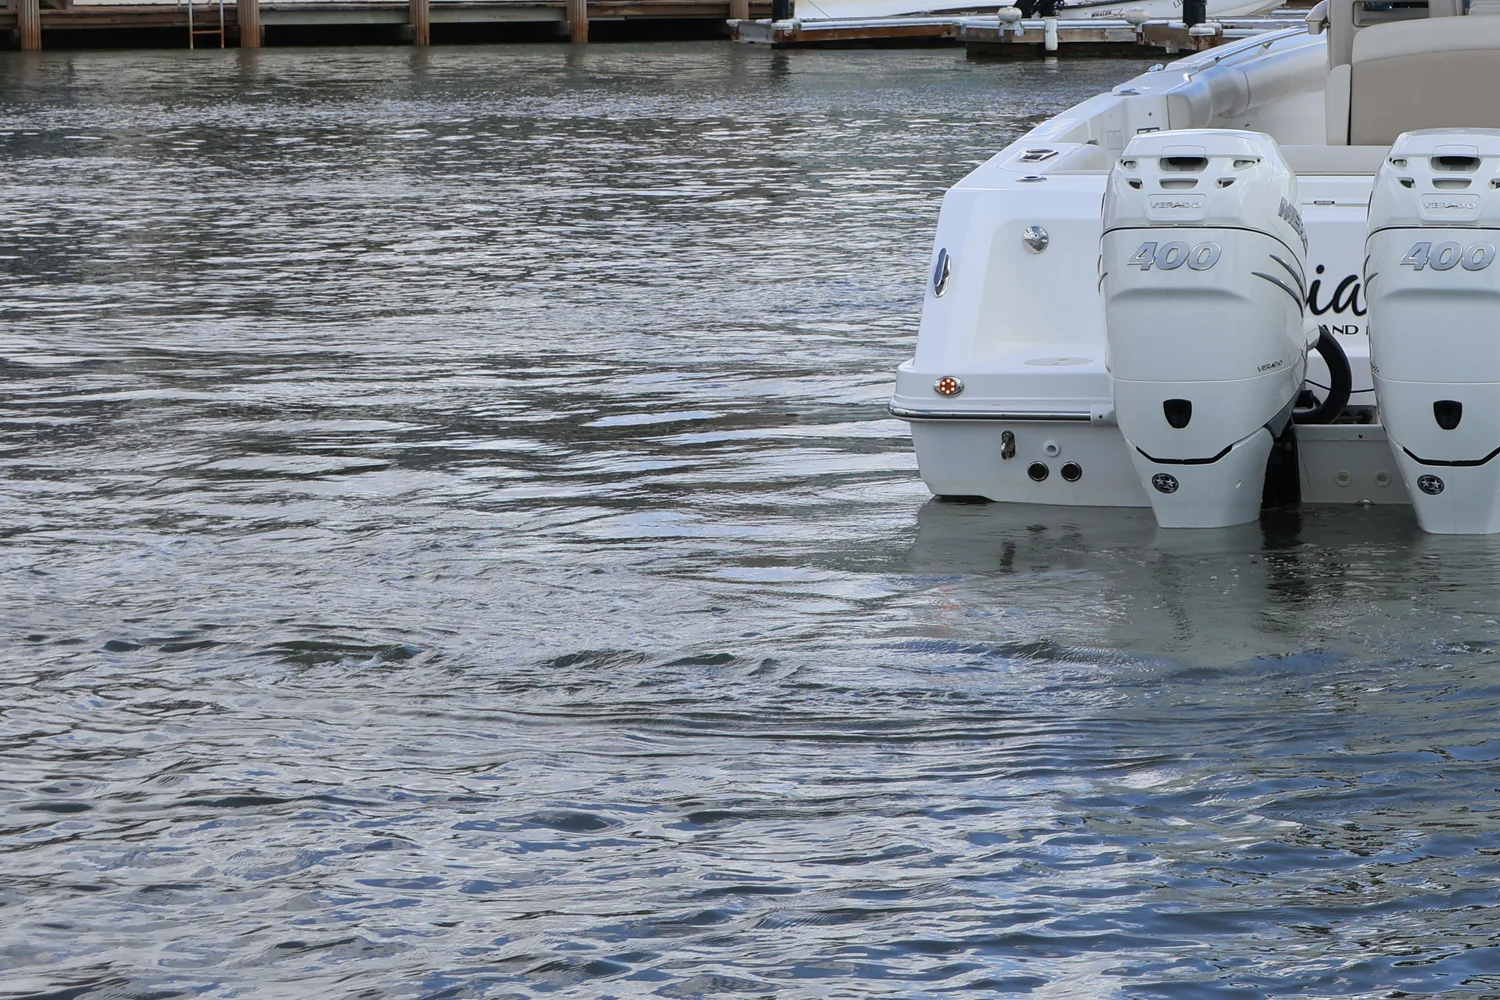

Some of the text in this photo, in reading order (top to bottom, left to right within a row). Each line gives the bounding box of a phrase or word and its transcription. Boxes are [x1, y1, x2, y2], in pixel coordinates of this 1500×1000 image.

[1150, 201, 1202, 209] VERADO
[1423, 201, 1477, 210] VERADO
[1126, 240, 1223, 271] 400
[1400, 240, 1497, 272] 400
[1256, 359, 1283, 373] VERADO
